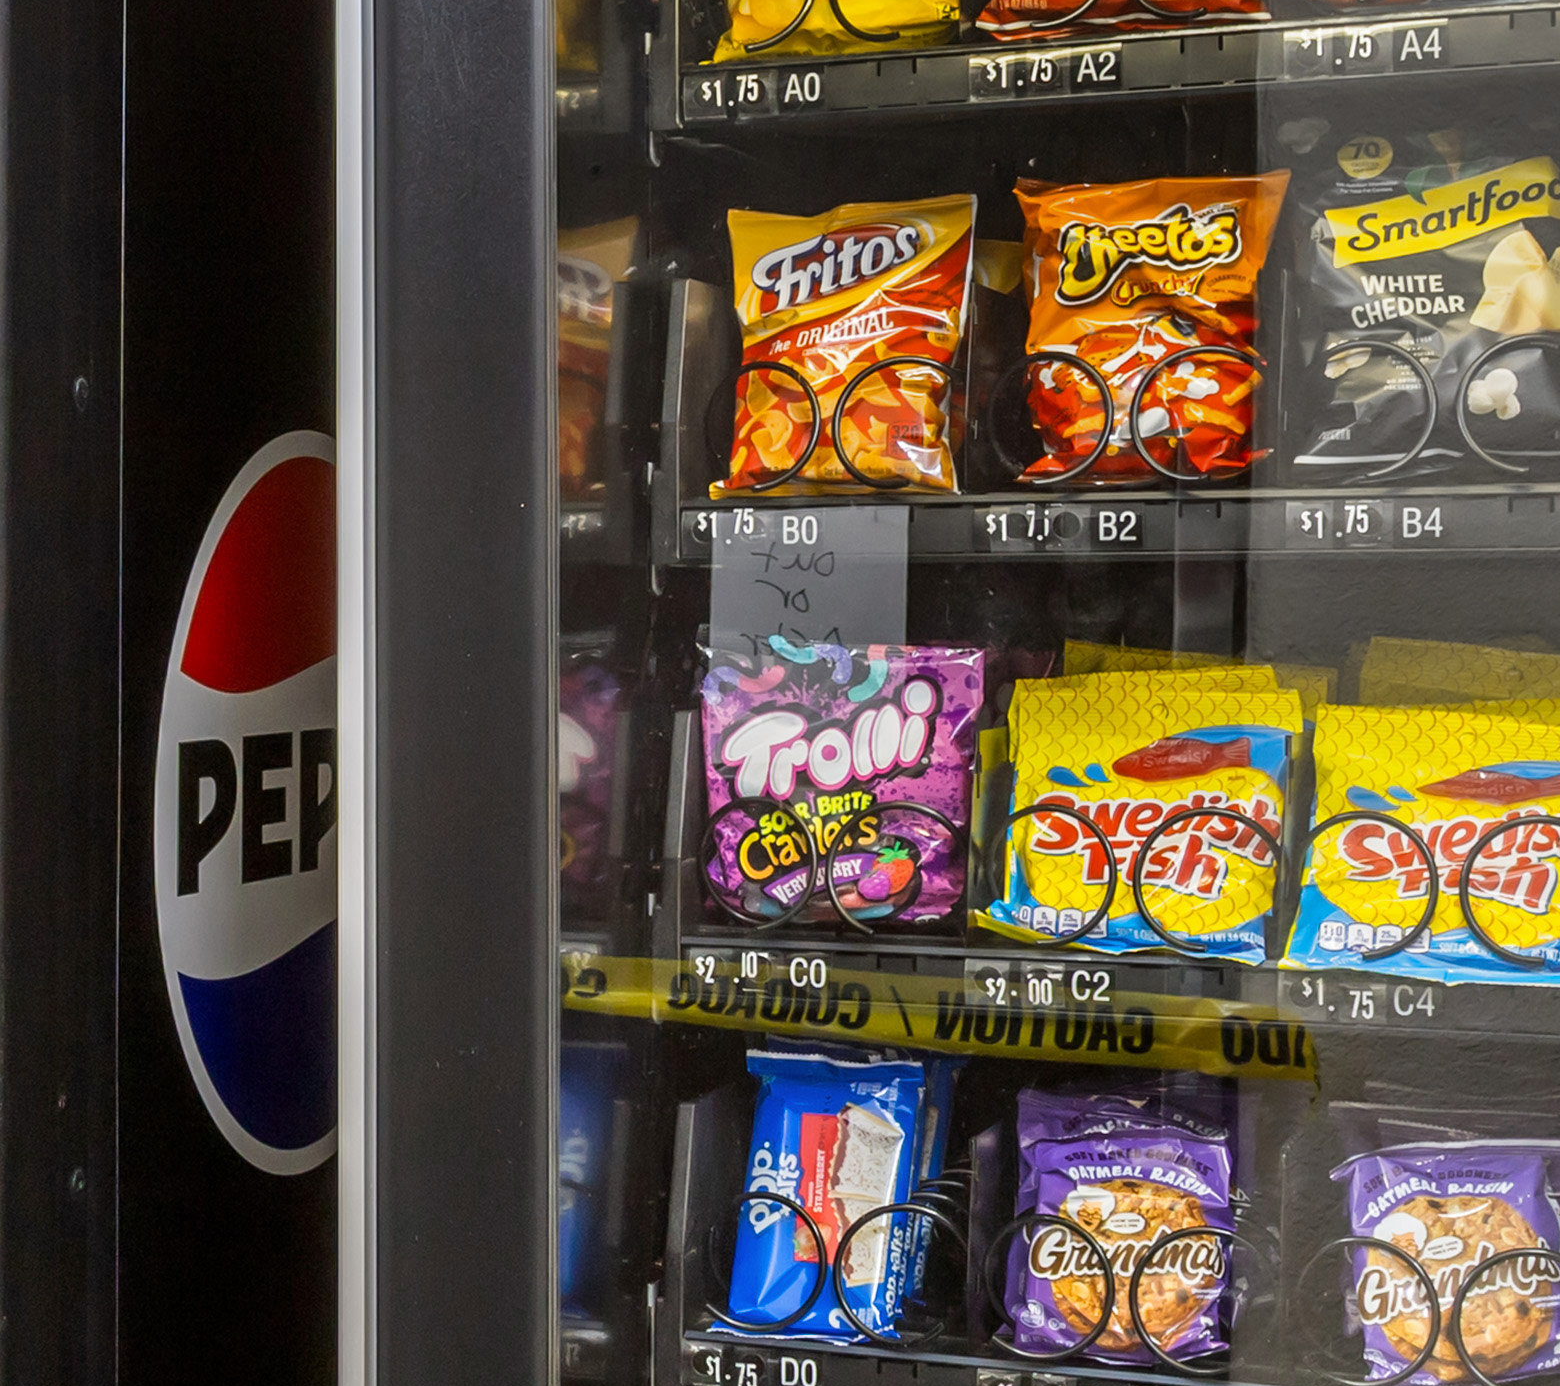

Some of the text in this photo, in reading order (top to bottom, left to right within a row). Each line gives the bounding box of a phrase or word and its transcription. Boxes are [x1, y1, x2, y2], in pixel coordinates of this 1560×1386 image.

[1400, 27, 1443, 61] A4
[1077, 50, 1117, 83] A2
[783, 71, 821, 103] A0
[752, 223, 919, 311] Fritos
[1063, 213, 1237, 295] Cheetos
[1360, 274, 1444, 296] WHITE
[1350, 294, 1466, 329] CHEDDAR
[781, 514, 819, 546] B0
[1097, 510, 1137, 542] B2
[1401, 506, 1444, 538] B4
[722, 679, 939, 799] Trolli
[789, 960, 827, 988] C0
[1070, 971, 1110, 1002] C2
[1393, 985, 1435, 1017] C4
[1067, 1164, 1212, 1197] OATMEAL RAISIN
